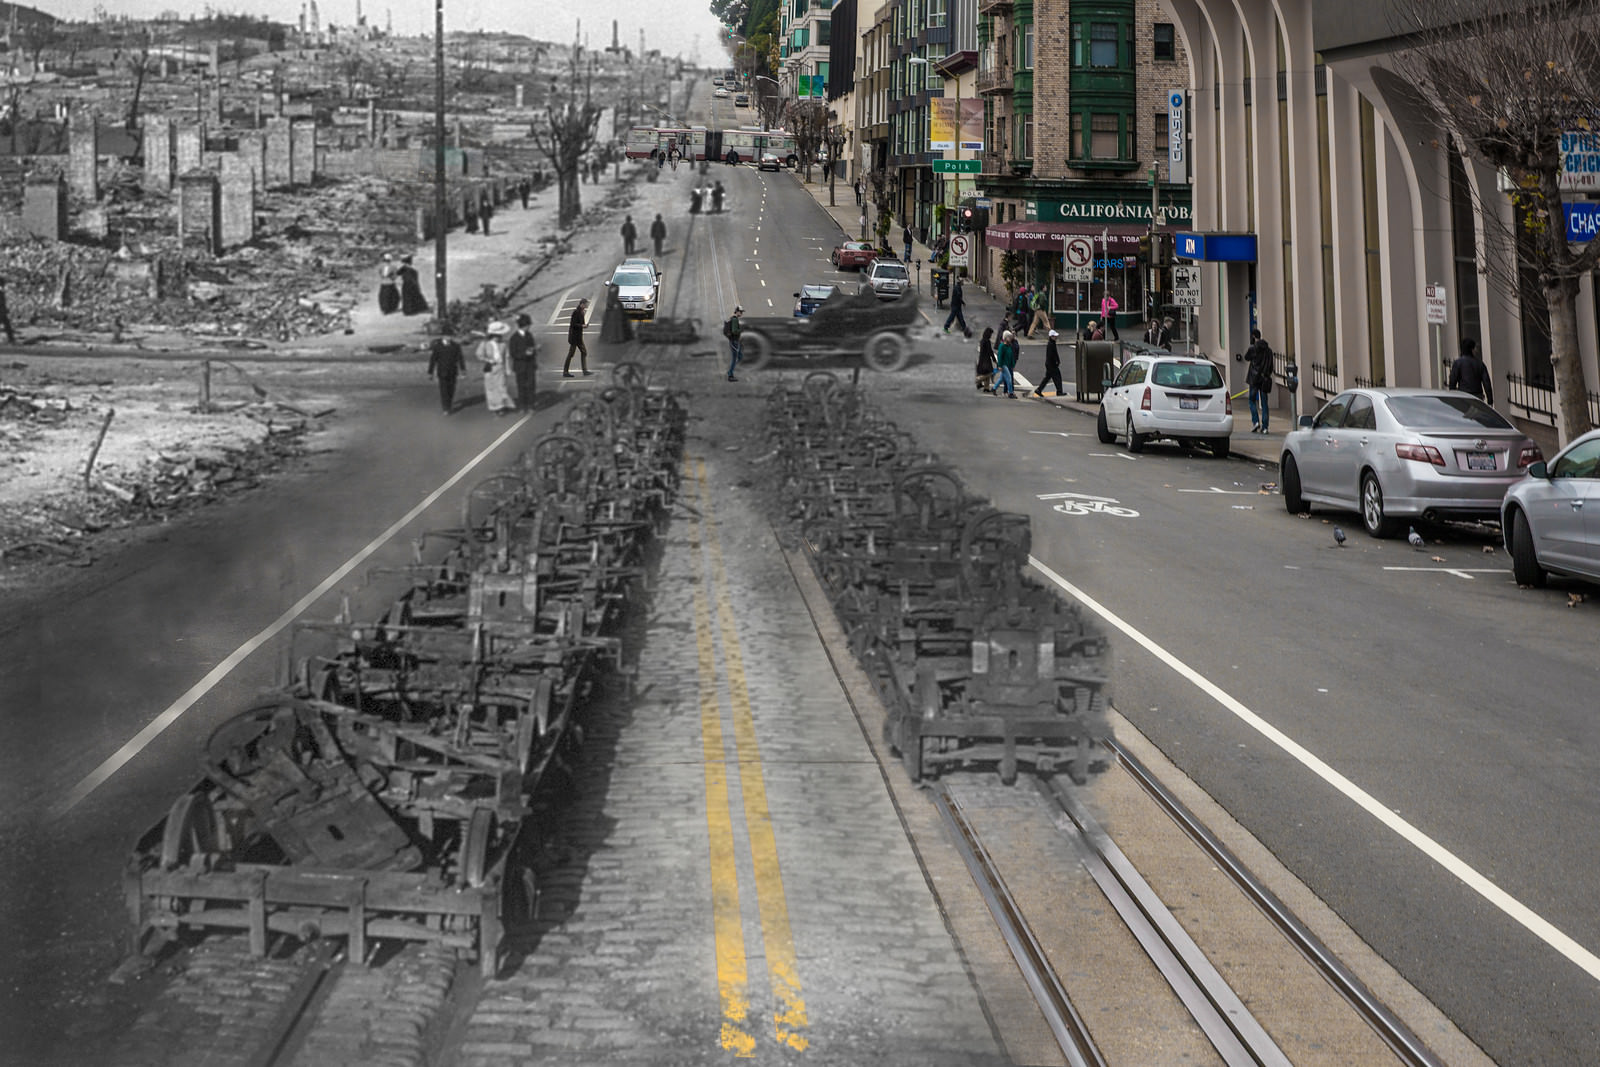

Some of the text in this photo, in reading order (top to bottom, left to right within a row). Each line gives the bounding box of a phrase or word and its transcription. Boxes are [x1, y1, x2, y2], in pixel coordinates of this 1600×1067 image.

[1172, 109, 1182, 162] CHASE
[944, 162, 971, 171] Polk
[1060, 203, 1154, 219] CALIFORNIA
[1014, 232, 1046, 240] DISCOUNT
[1185, 238, 1196, 255] ATM
[1175, 289, 1199, 297] DO NOT
[1427, 287, 1435, 297] NO
